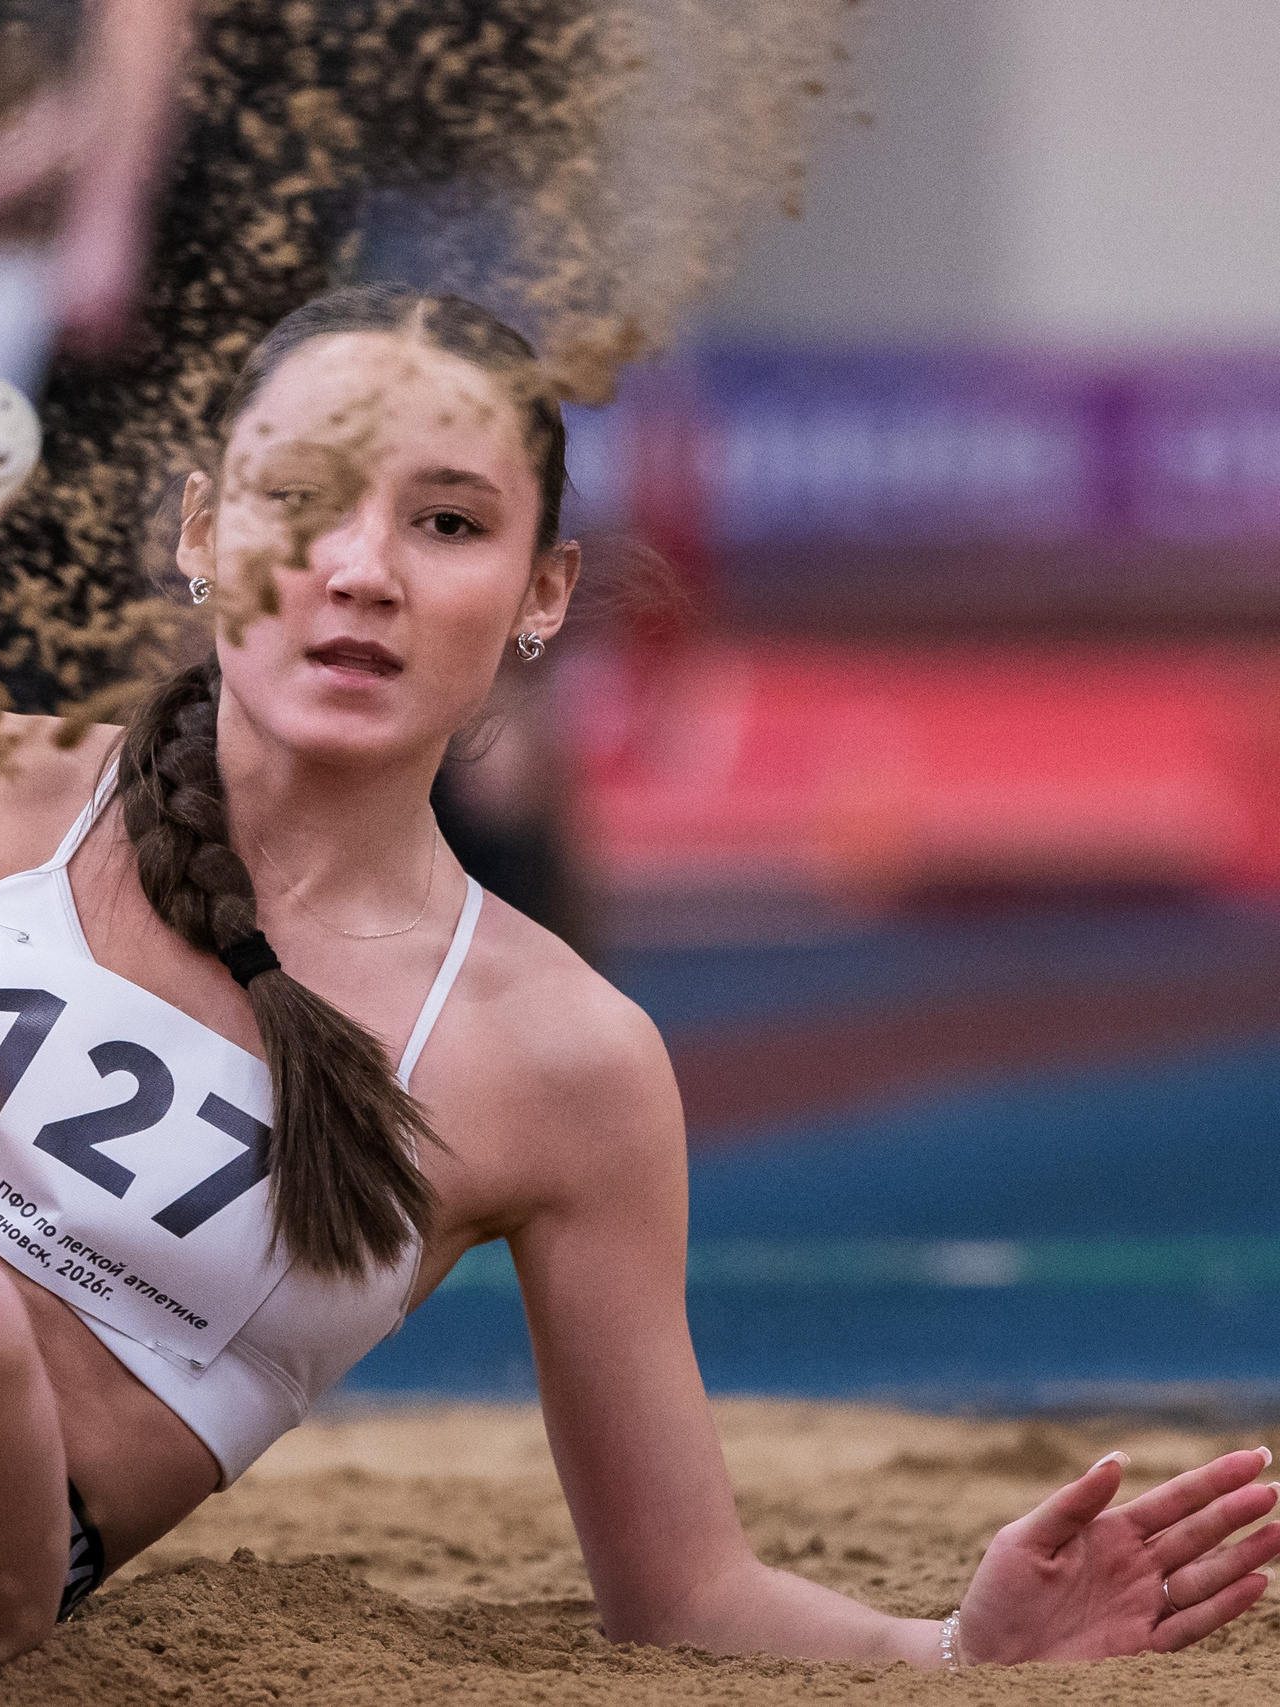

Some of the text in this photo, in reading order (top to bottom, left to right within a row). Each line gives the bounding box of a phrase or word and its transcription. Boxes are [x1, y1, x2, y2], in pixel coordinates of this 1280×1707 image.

[33, 1217, 57, 1237] по
[57, 1235, 127, 1277] легкой
[123, 1274, 209, 1330] атлетике
[55, 1259, 114, 1301] 2026г.
